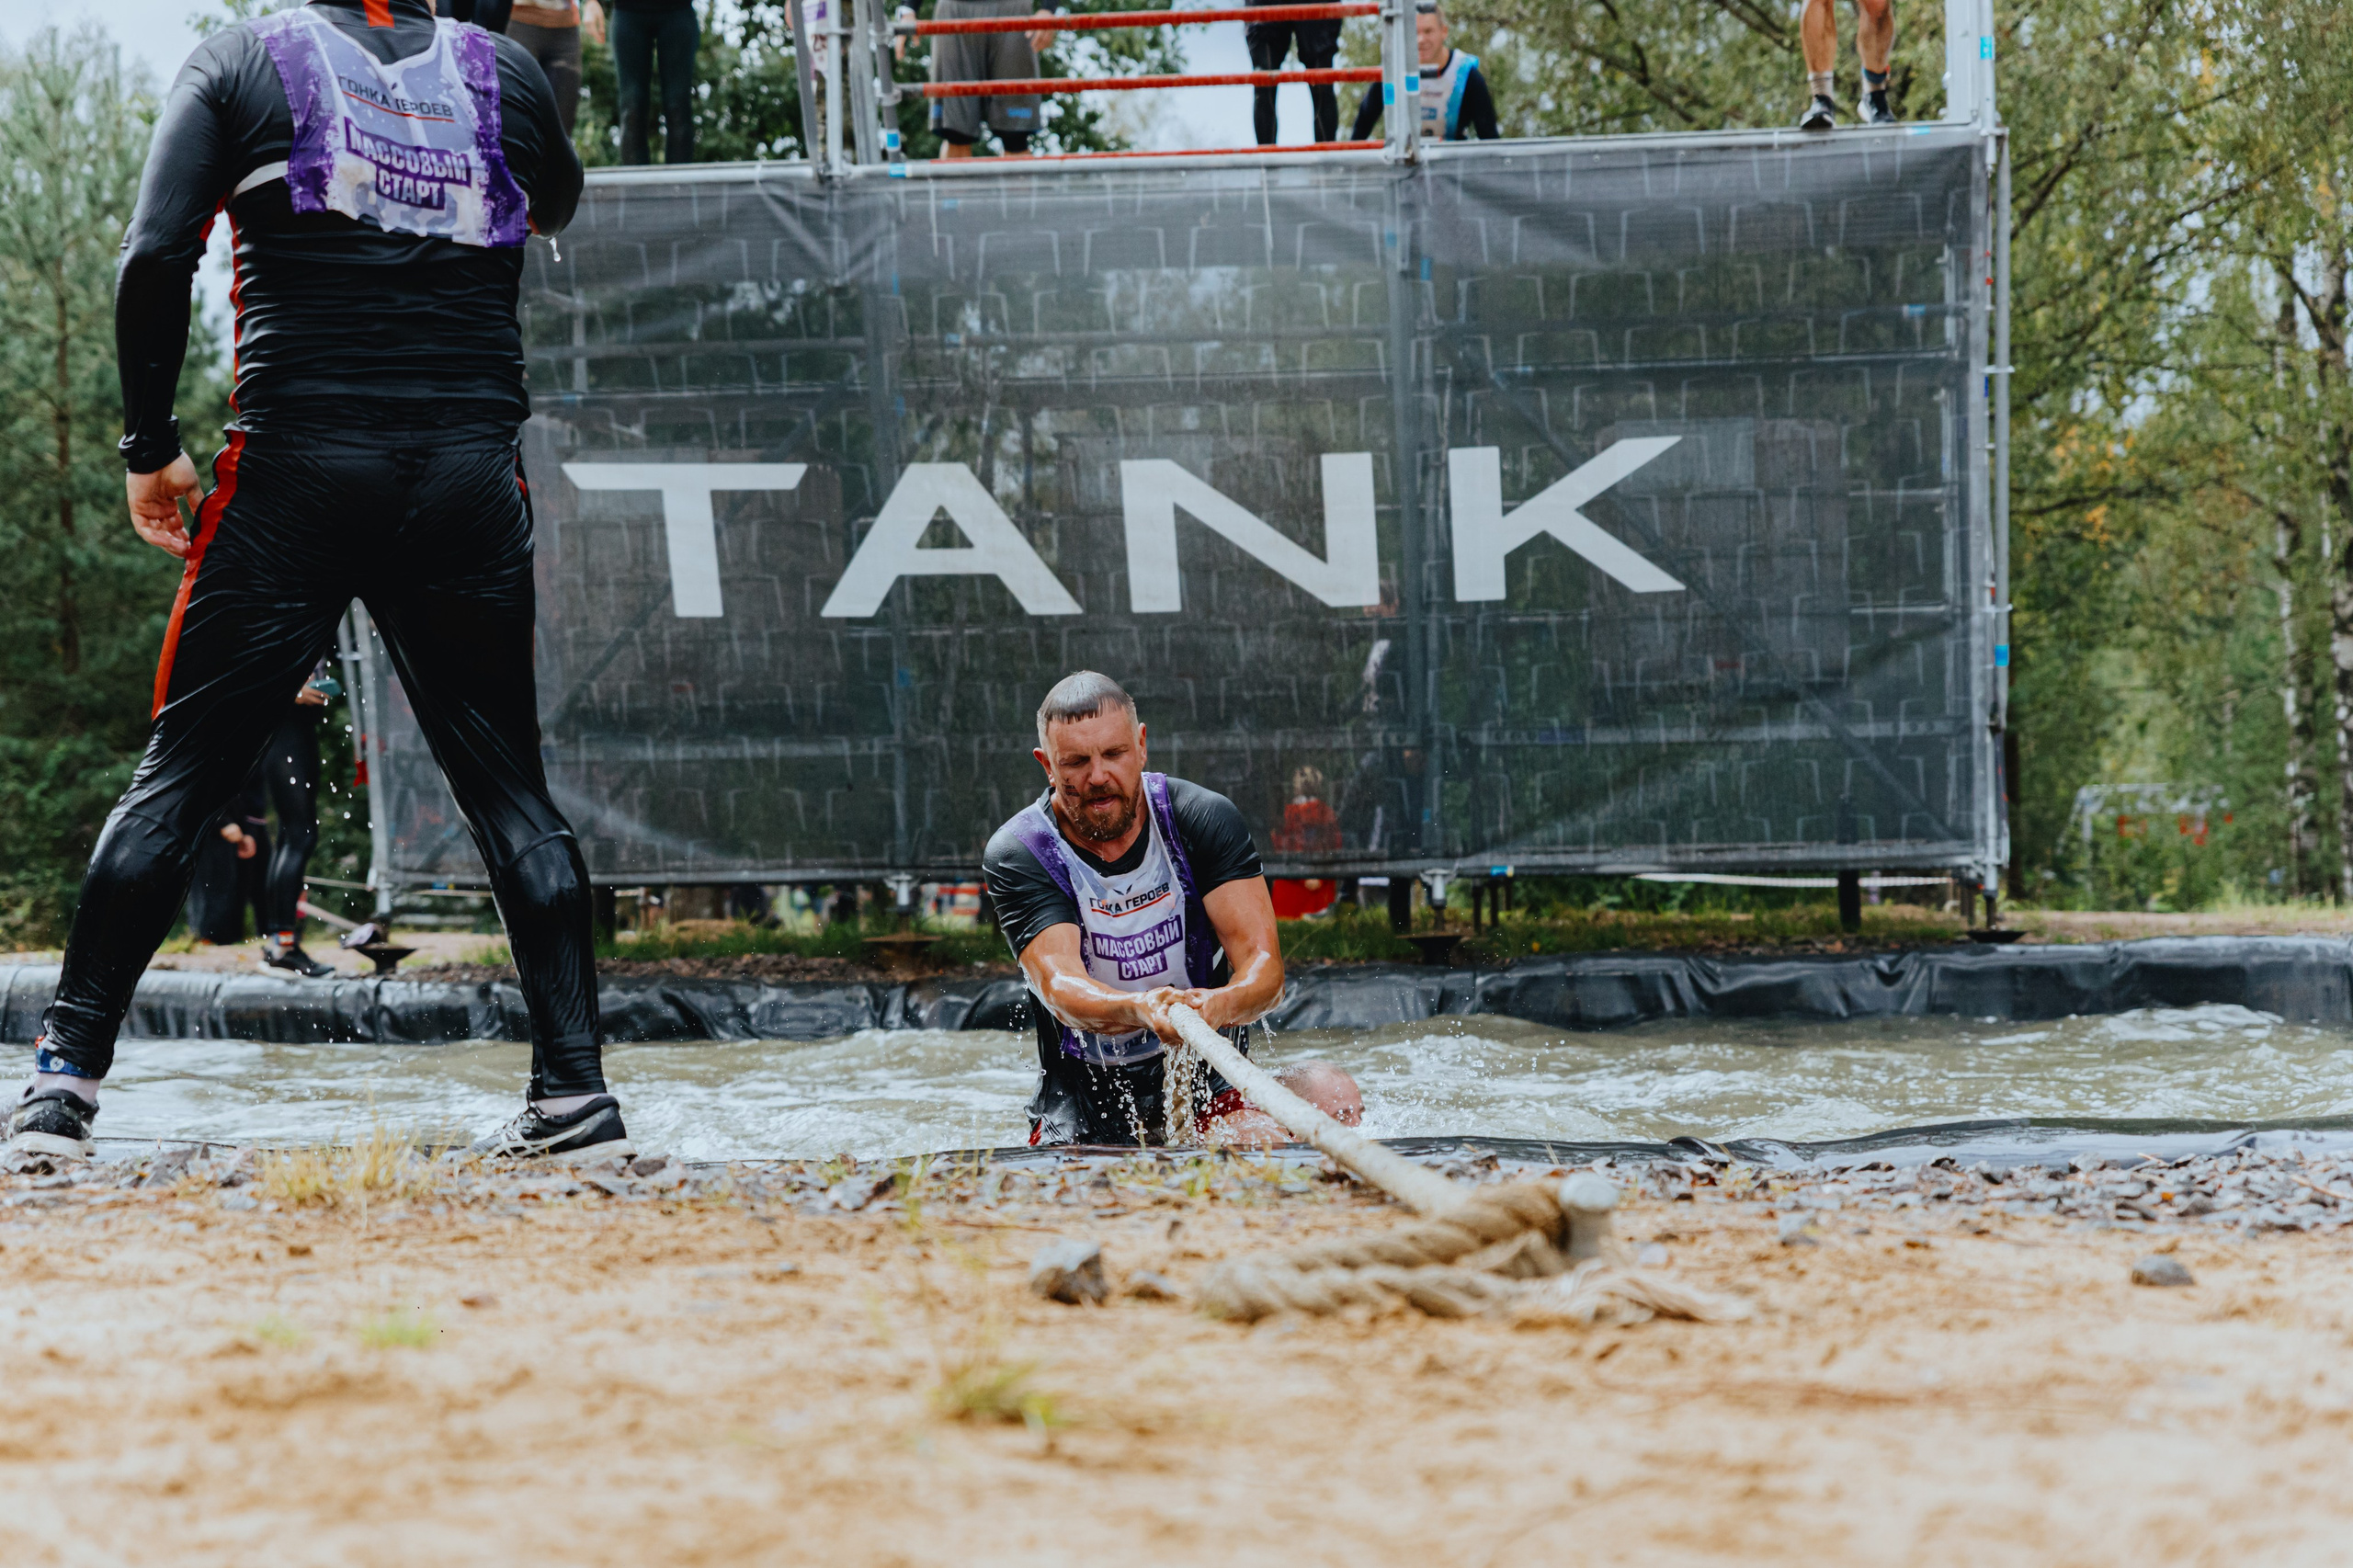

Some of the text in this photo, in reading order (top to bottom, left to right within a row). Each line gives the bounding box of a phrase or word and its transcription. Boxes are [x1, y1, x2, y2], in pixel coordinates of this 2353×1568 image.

[337, 75, 391, 108] ГОНКА
[378, 169, 441, 207] СТАРТ
[561, 435, 1687, 619] TANK
[1089, 882, 1170, 915] ГОКА ГЕРОЕВ
[1095, 915, 1180, 959] МАССОВЫЙ
[1121, 951, 1164, 979] СТАРТ
